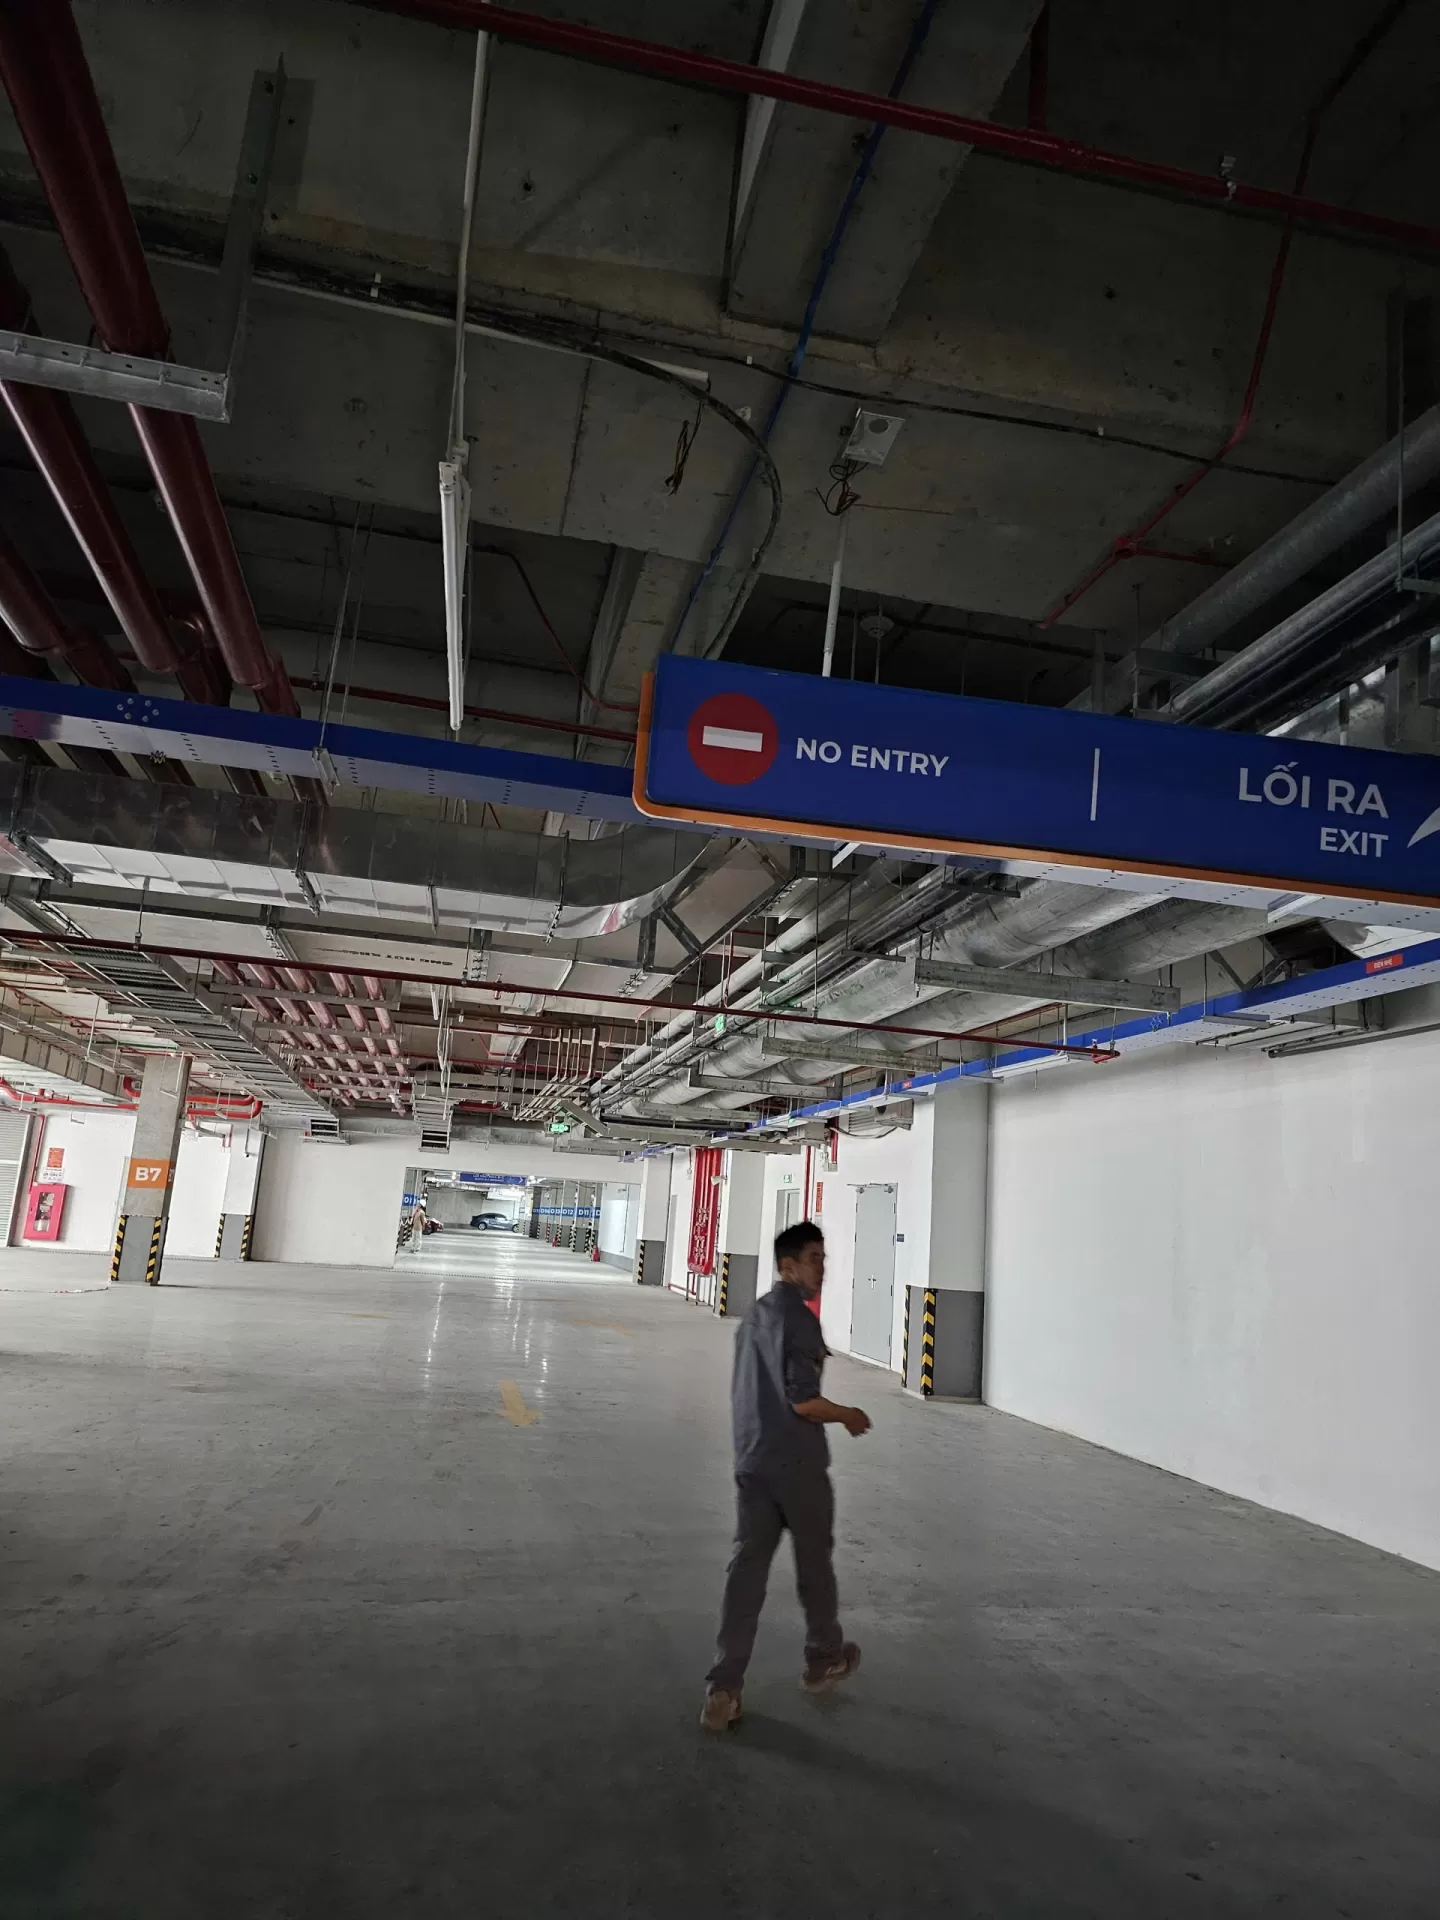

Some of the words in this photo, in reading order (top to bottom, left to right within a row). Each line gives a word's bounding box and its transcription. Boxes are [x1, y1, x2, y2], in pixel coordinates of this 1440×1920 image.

[796, 737, 842, 764] NO
[851, 744, 949, 778] ENTRY
[1238, 761, 1310, 808] LỐI
[1328, 779, 1389, 818] RA
[1320, 827, 1389, 858] EXIT
[135, 1166, 162, 1182] B7
